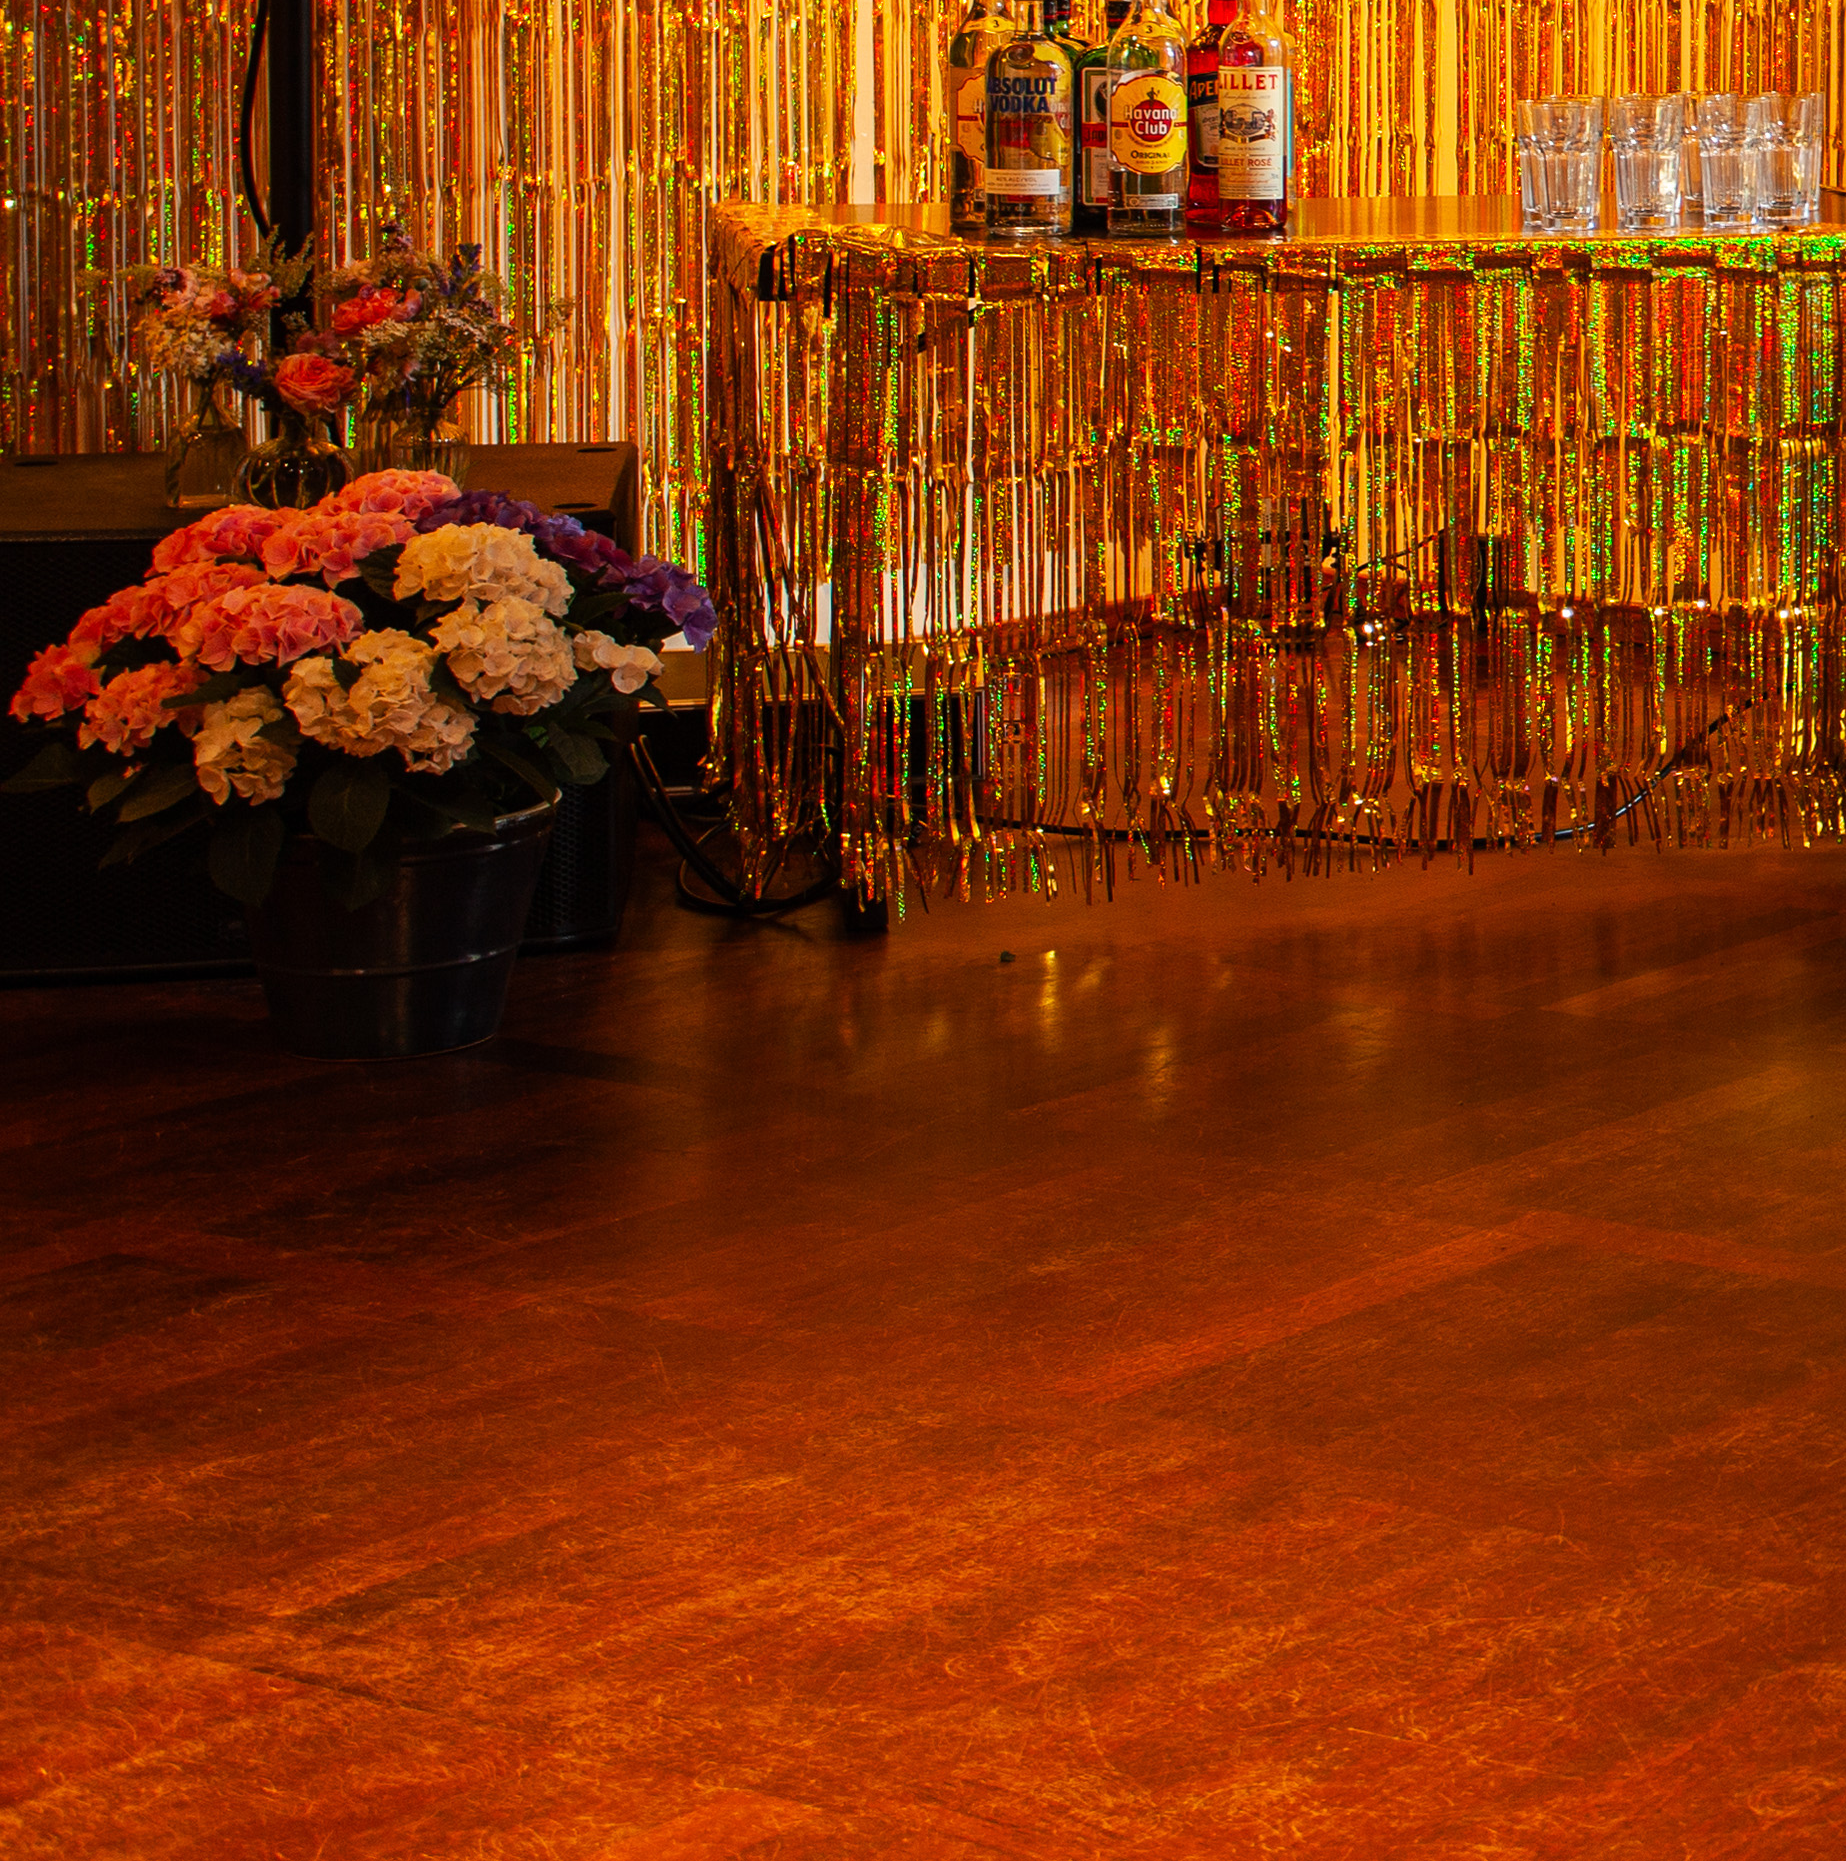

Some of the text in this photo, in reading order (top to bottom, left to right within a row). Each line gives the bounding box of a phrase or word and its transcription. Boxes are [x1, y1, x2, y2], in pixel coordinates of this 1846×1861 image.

[993, 19, 1000, 28] 3
[1145, 25, 1153, 34] 3
[1218, 74, 1278, 90] ILLET
[990, 95, 1051, 113] VODKA
[1124, 106, 1179, 120] Havana
[1135, 121, 1168, 135] Club
